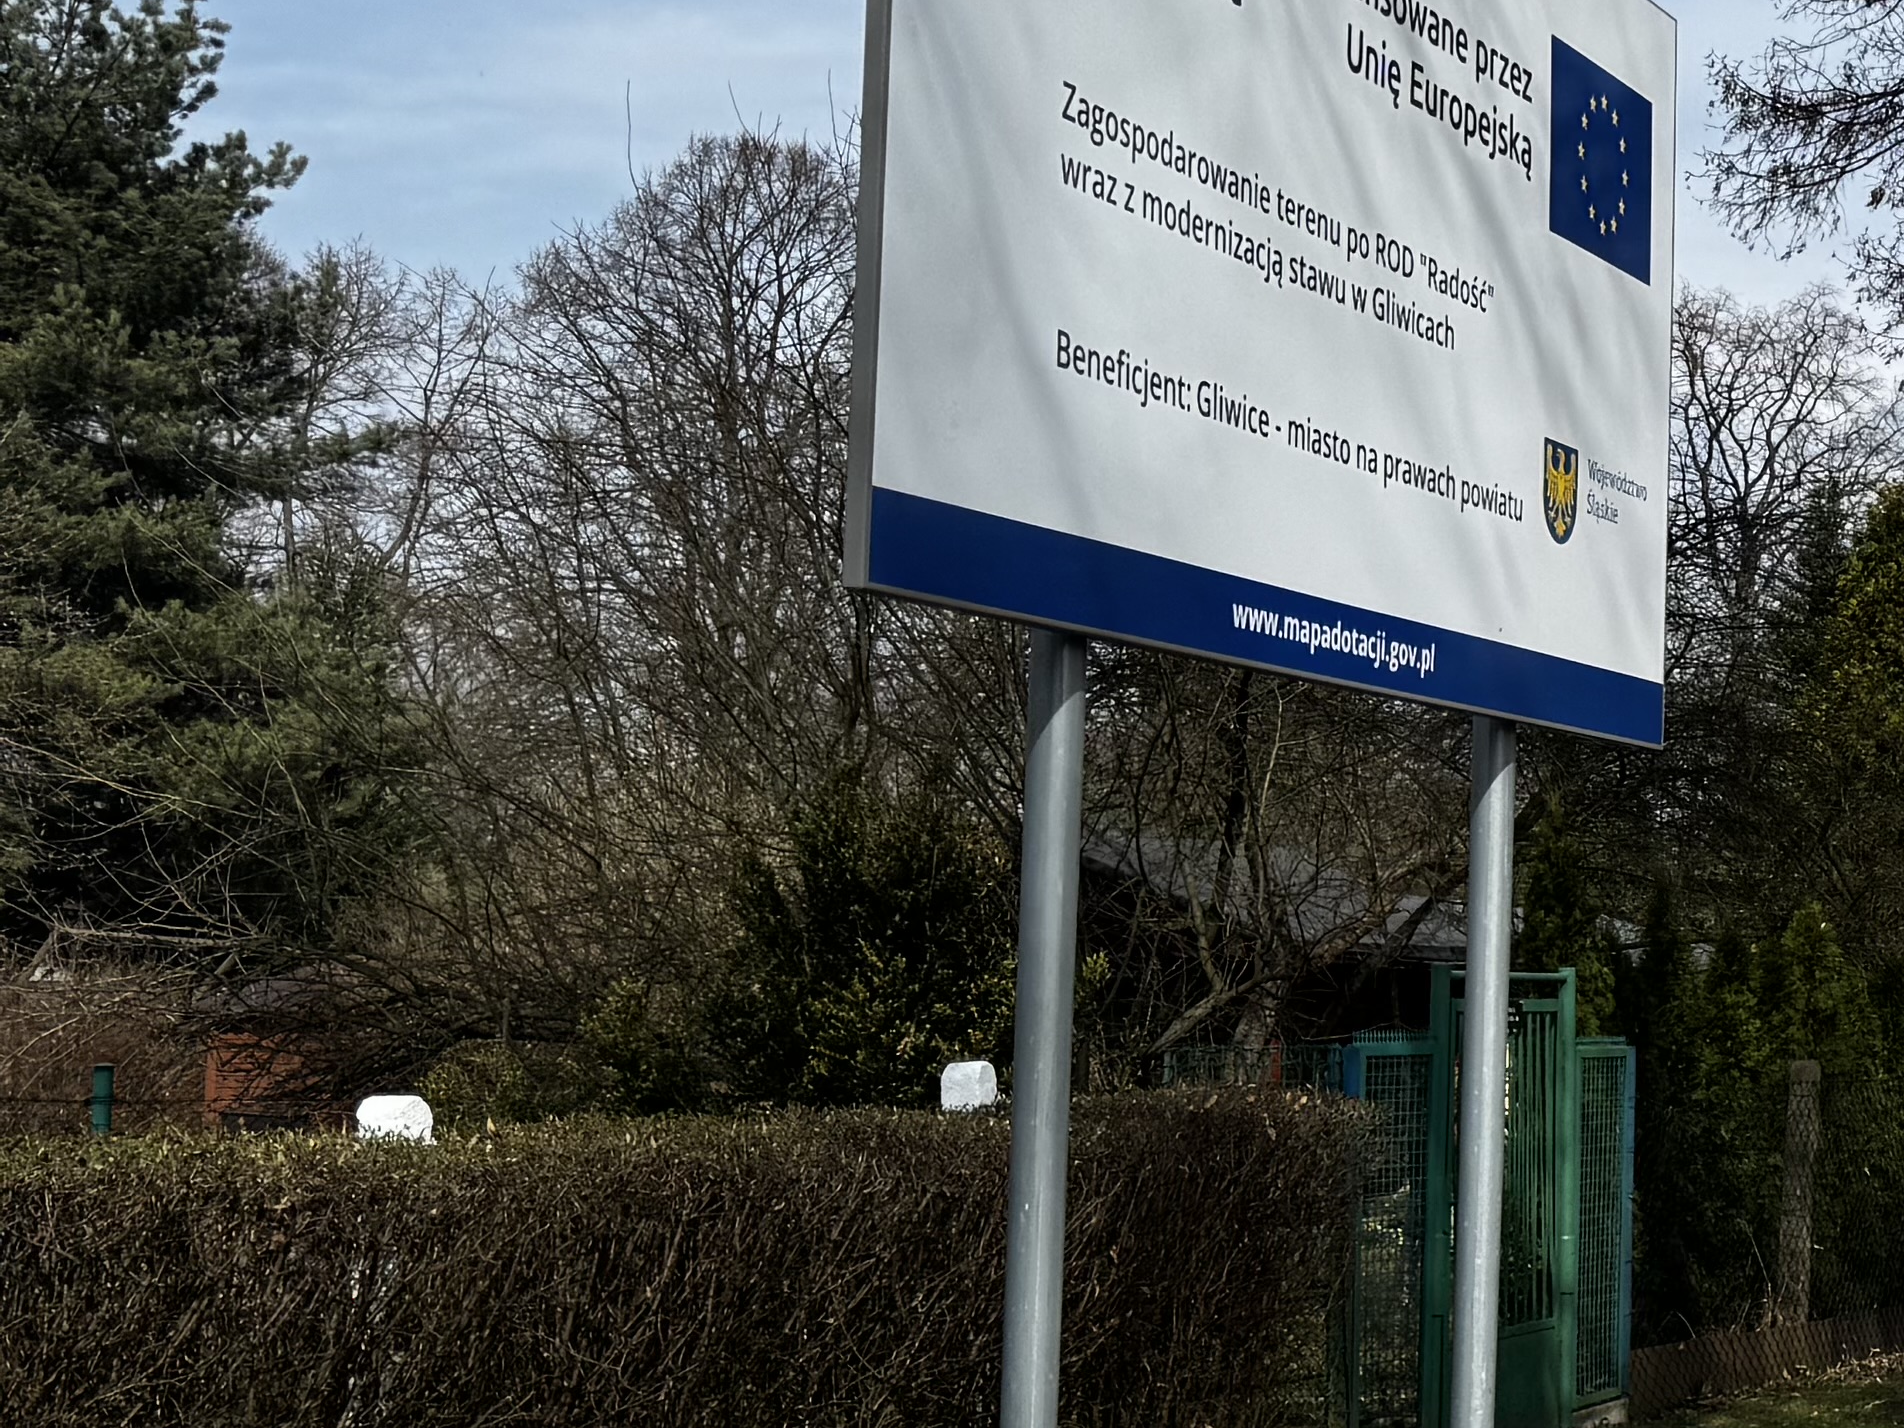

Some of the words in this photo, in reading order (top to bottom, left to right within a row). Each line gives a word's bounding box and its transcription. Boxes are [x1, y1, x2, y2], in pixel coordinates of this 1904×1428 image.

[1347, 23, 1401, 109] Unię
[1410, 61, 1532, 182] Europejską
[1476, 39, 1533, 104] przez
[1061, 153, 1117, 206] wraz
[1124, 183, 1135, 214] z
[1143, 190, 1283, 289] modernizacją
[1289, 256, 1345, 305] stawu
[1352, 283, 1367, 313] w
[1373, 287, 1455, 350] Gliwicach
[1062, 80, 1271, 214] Zagospodarowanie
[1277, 188, 1341, 247] terenu
[1347, 227, 1370, 262] po
[1376, 233, 1414, 278] ROD
[1420, 253, 1494, 312] "Radość"
[1057, 329, 1191, 412] Beneficjent:
[1197, 381, 1270, 438] Gliwice
[1288, 417, 1350, 465] miasto
[1357, 443, 1377, 475] na
[1384, 453, 1455, 500] prawach
[1461, 479, 1523, 522] powiatu
[1232, 603, 1436, 679] www.mapadotacji.gov.pl
